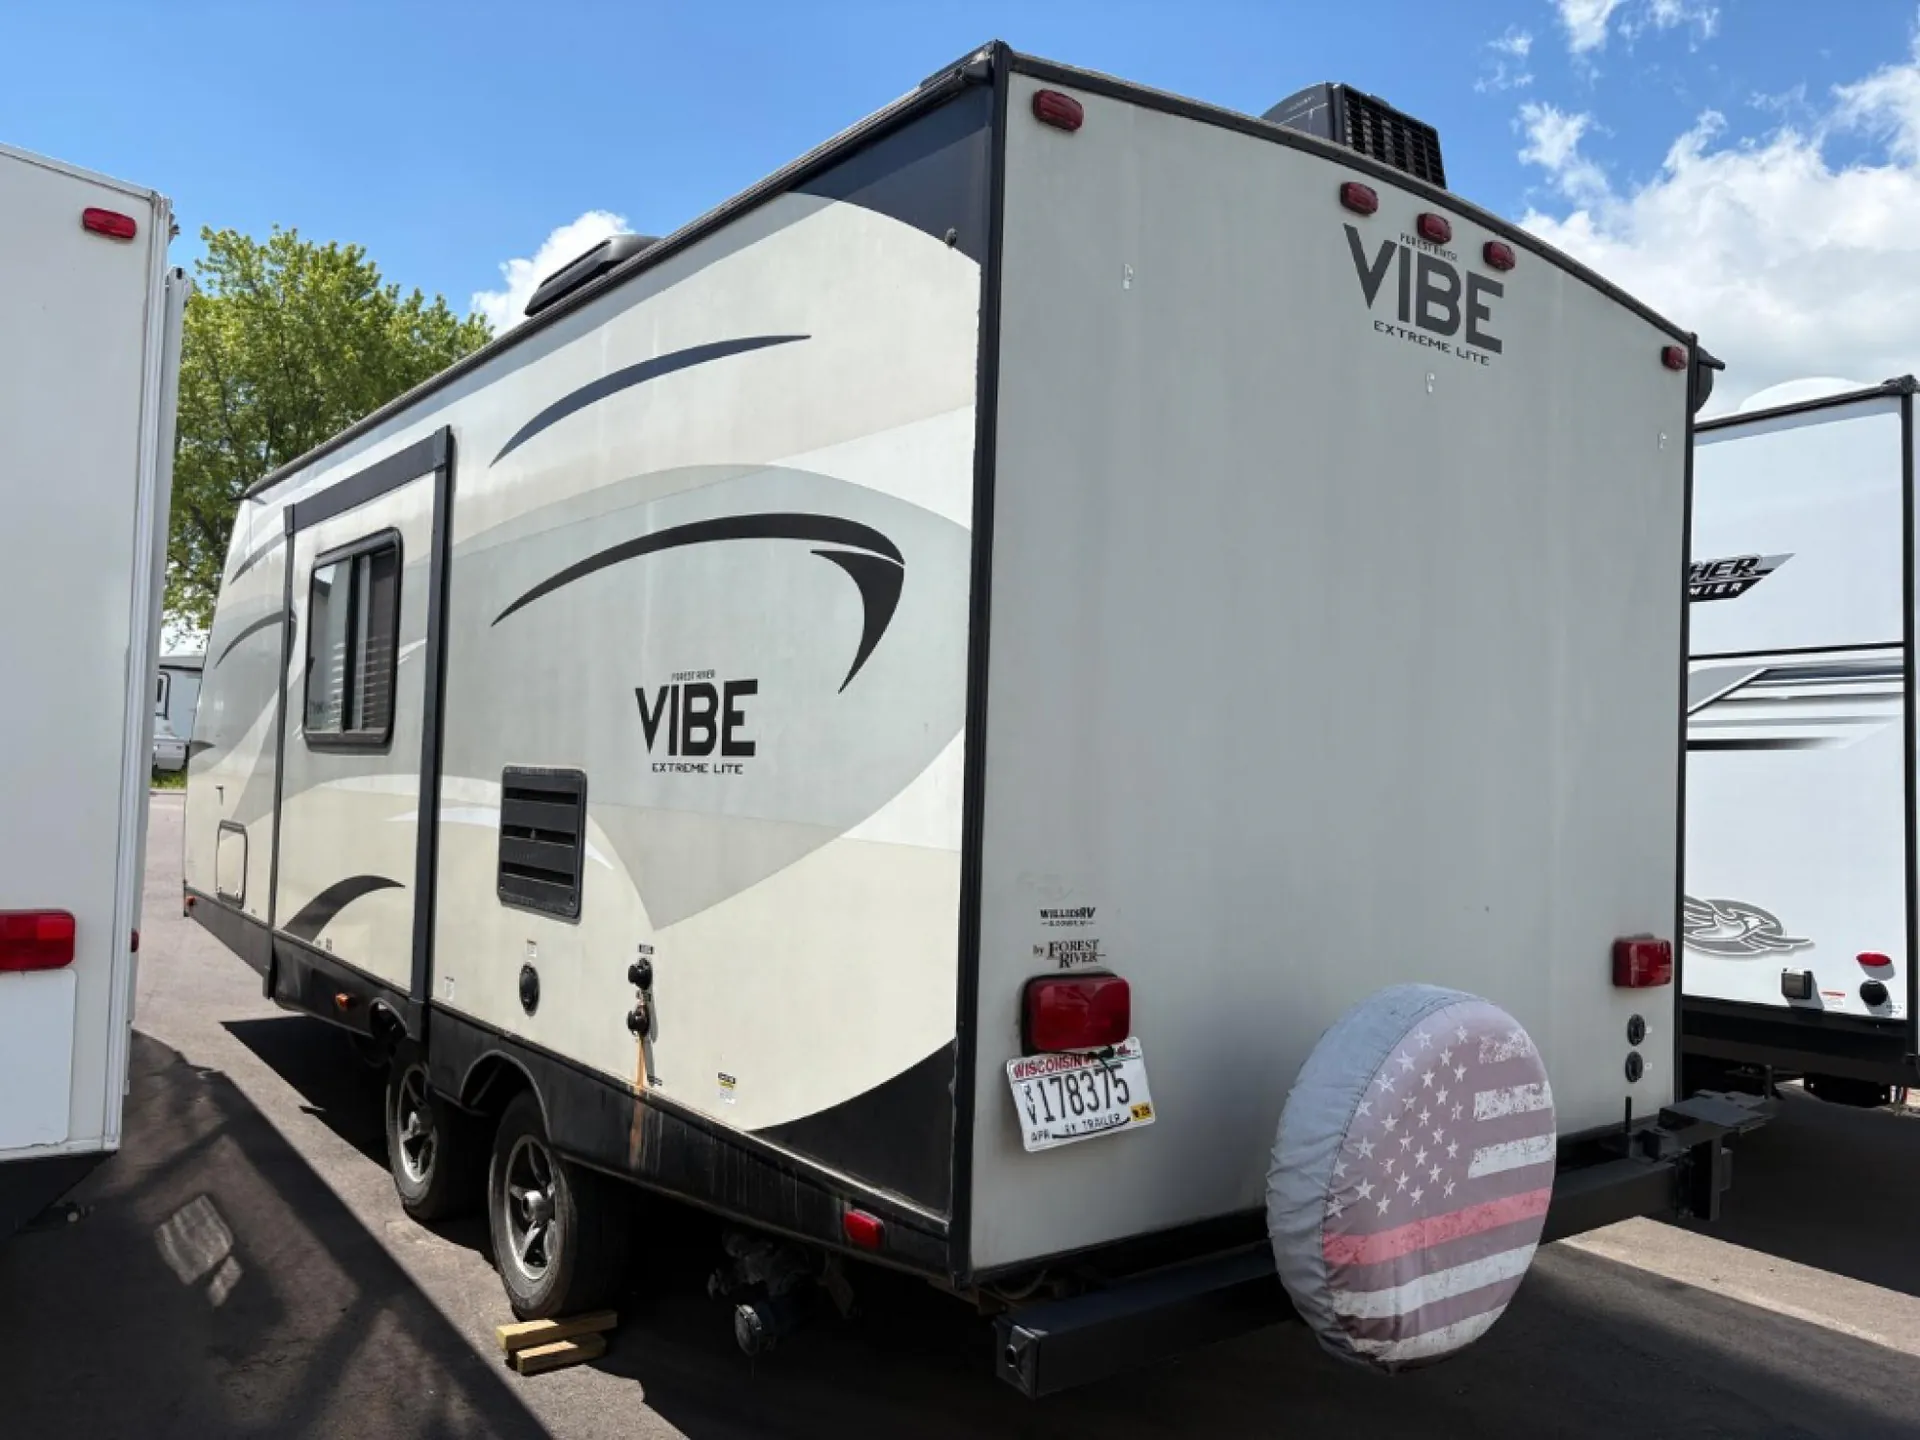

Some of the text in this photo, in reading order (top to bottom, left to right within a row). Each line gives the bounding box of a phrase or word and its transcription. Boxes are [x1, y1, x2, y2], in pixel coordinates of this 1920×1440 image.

[1343, 222, 1504, 355] VIBE
[1373, 319, 1490, 366] EXTREME LITE
[635, 679, 758, 756] VIBE
[652, 762, 744, 775] EXTREME LITE
[1014, 1053, 1083, 1078] WISCONSIN
[1036, 1064, 1130, 1123] 178375
